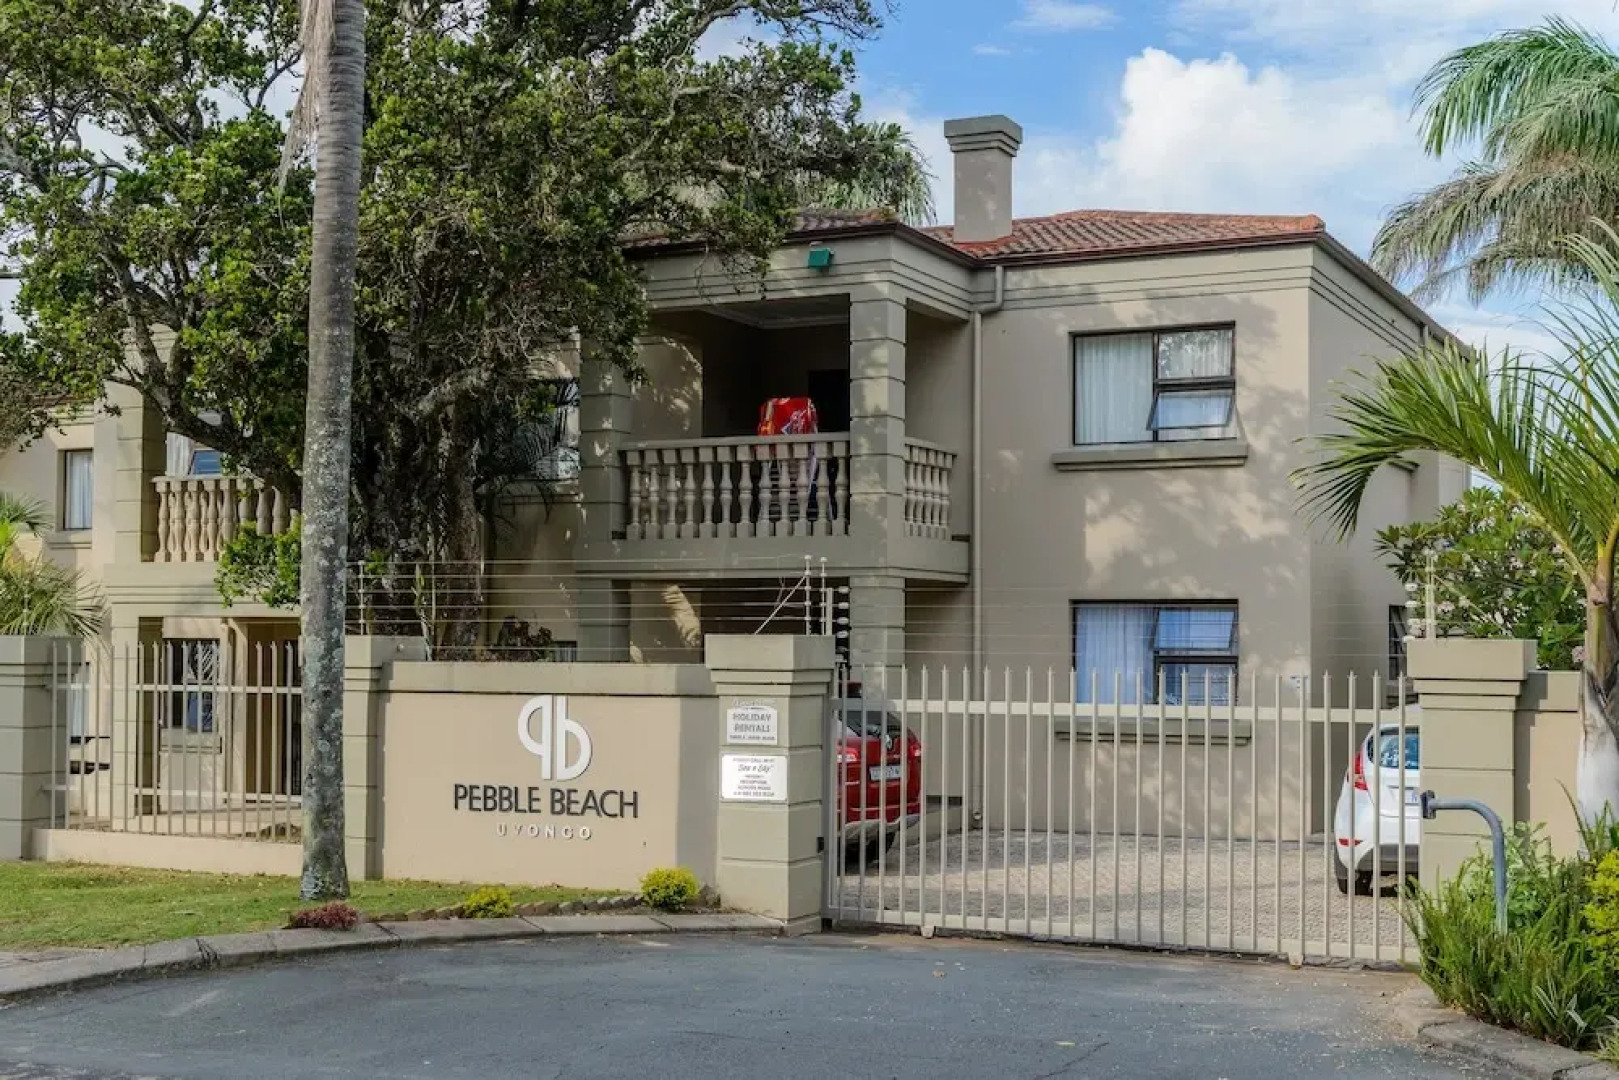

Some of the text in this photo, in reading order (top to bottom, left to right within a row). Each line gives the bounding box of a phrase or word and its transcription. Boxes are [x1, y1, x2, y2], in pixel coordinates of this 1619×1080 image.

[732, 713, 772, 721] HOLIDAY
[454, 784, 639, 818] PEBBLE BEACH
